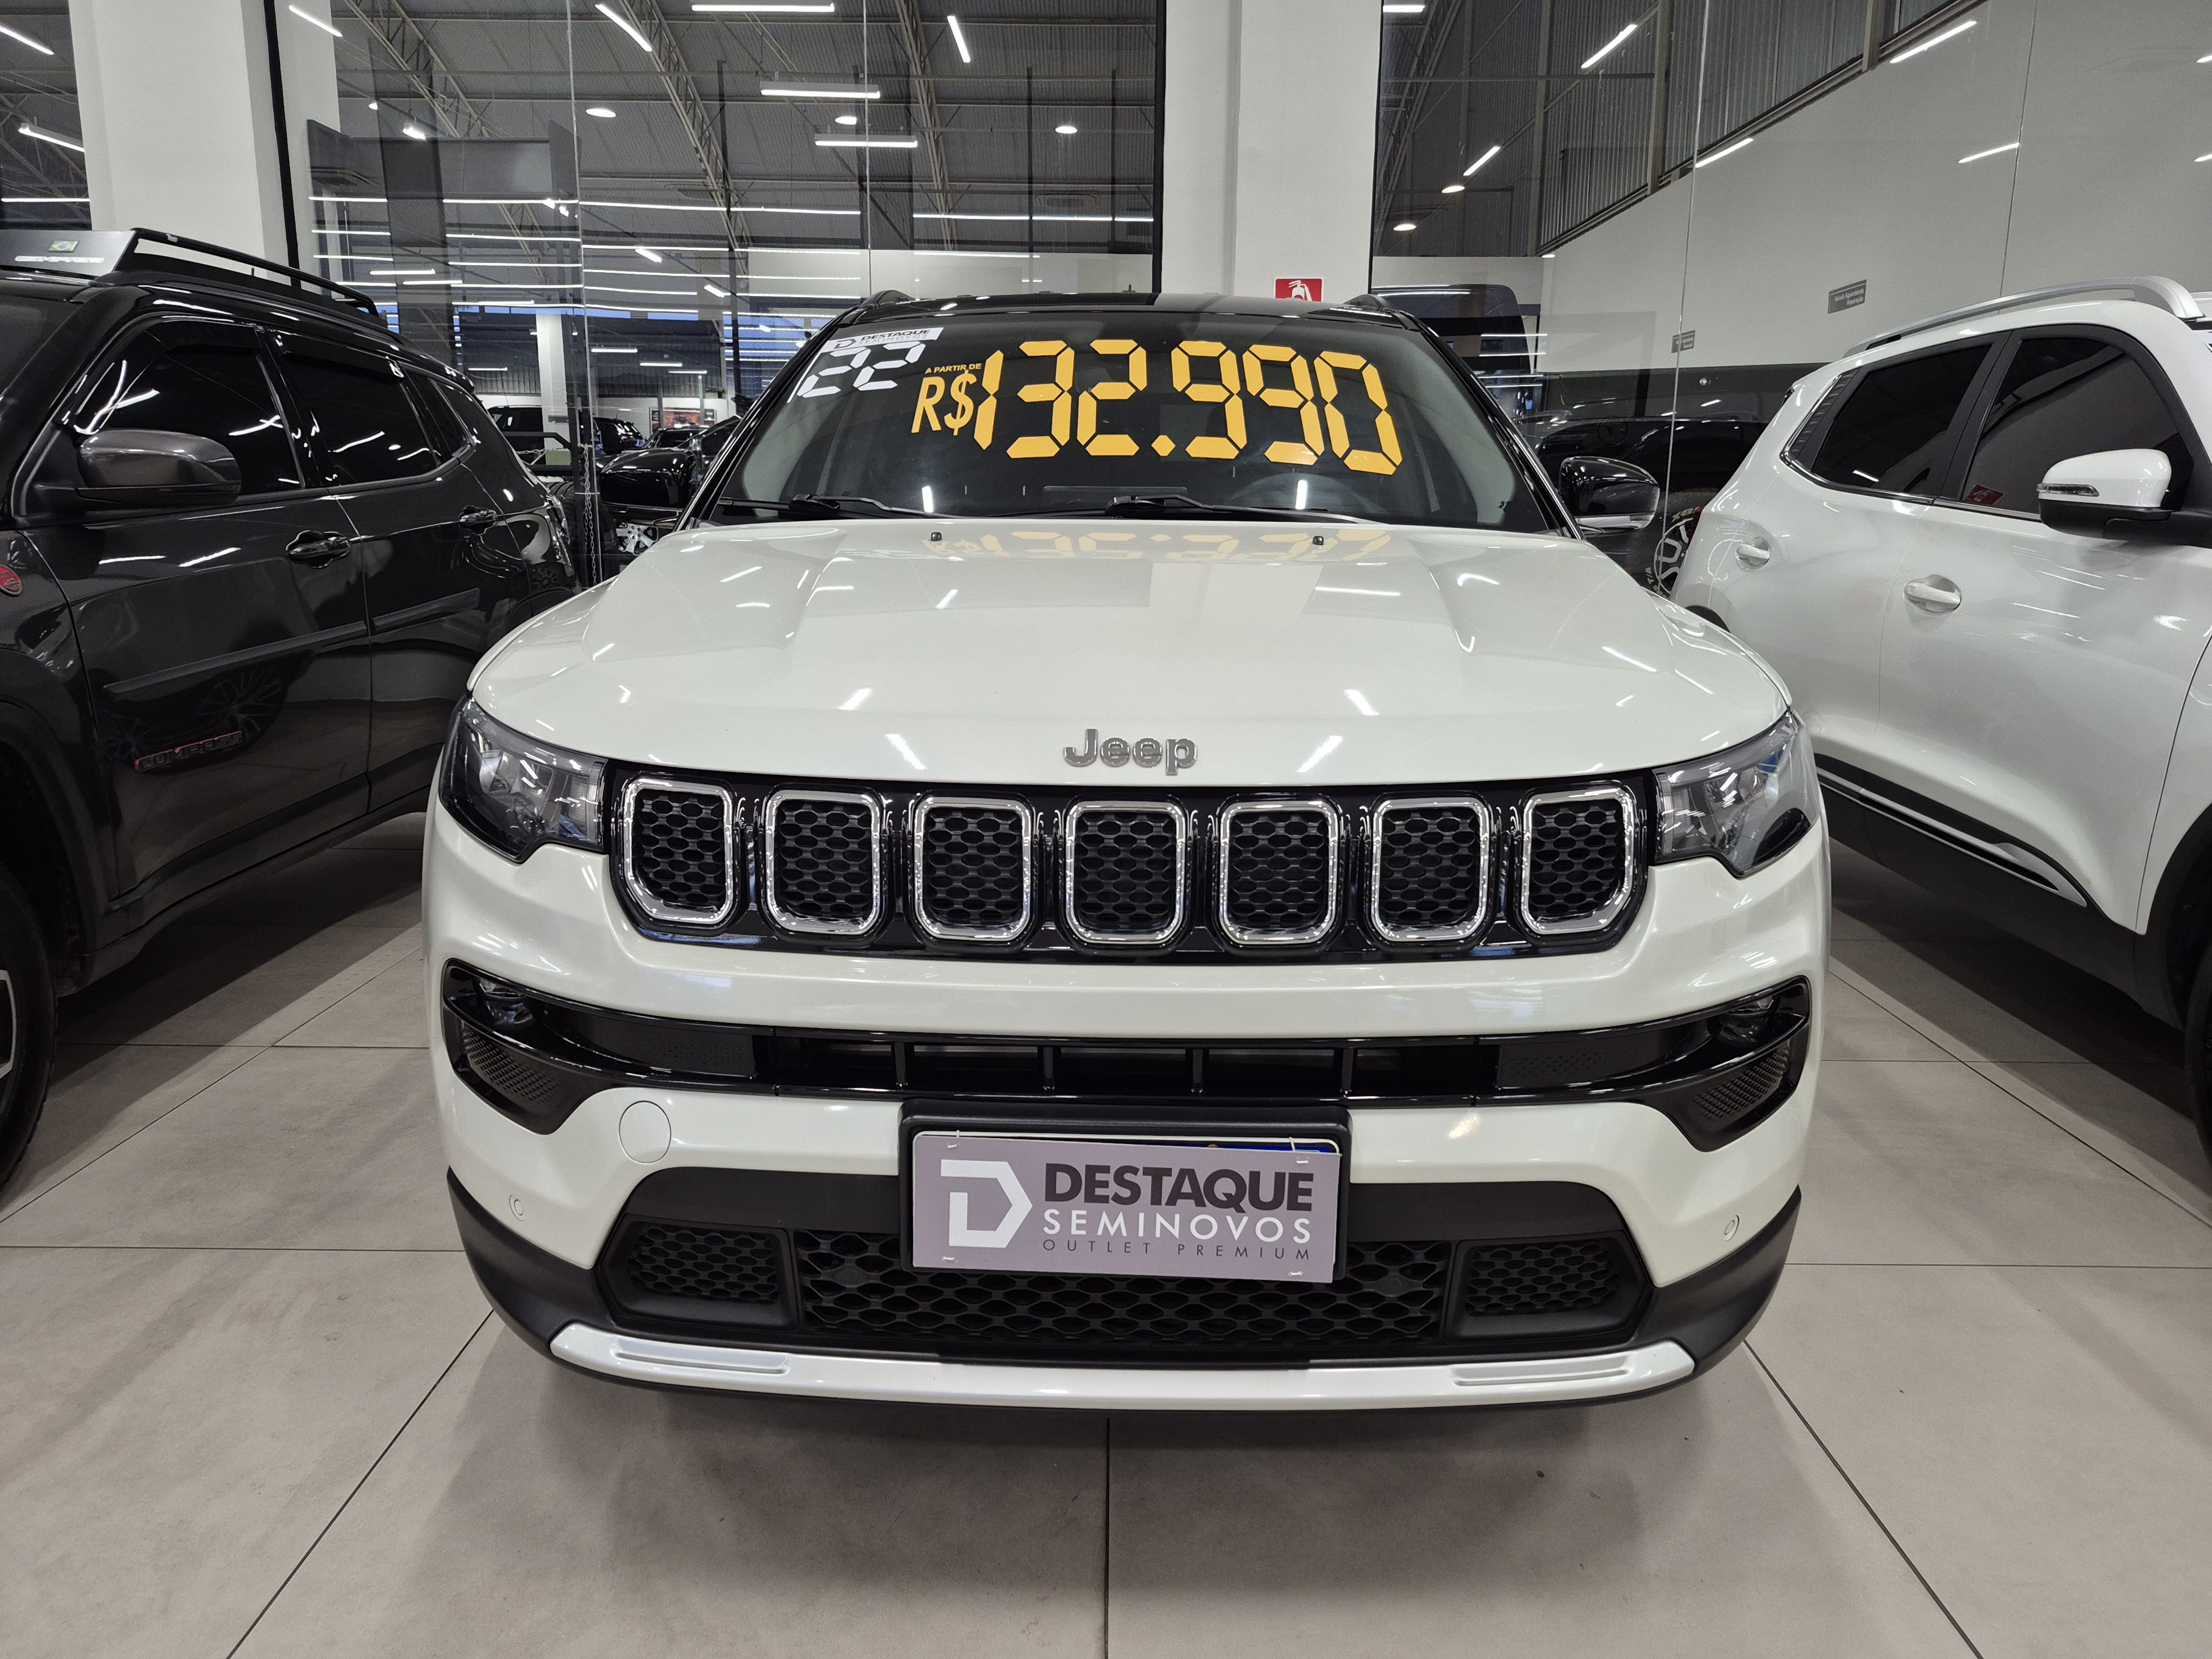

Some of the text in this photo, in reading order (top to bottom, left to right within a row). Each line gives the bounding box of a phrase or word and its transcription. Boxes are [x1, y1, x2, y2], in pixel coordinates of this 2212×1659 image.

[861, 329, 931, 341] DESTAQUE
[797, 341, 926, 398] 22
[933, 364, 967, 373] PARTIR
[911, 339, 1403, 476] R$ 132.990
[134, 731, 243, 773] COMPASS
[1063, 728, 1198, 776] Jeep
[1044, 1162, 1314, 1214] DESTAQUE
[1043, 1209, 1312, 1244] SEMINOVOS
[1042, 1239, 1310, 1260] OUTLET PREMIUM
